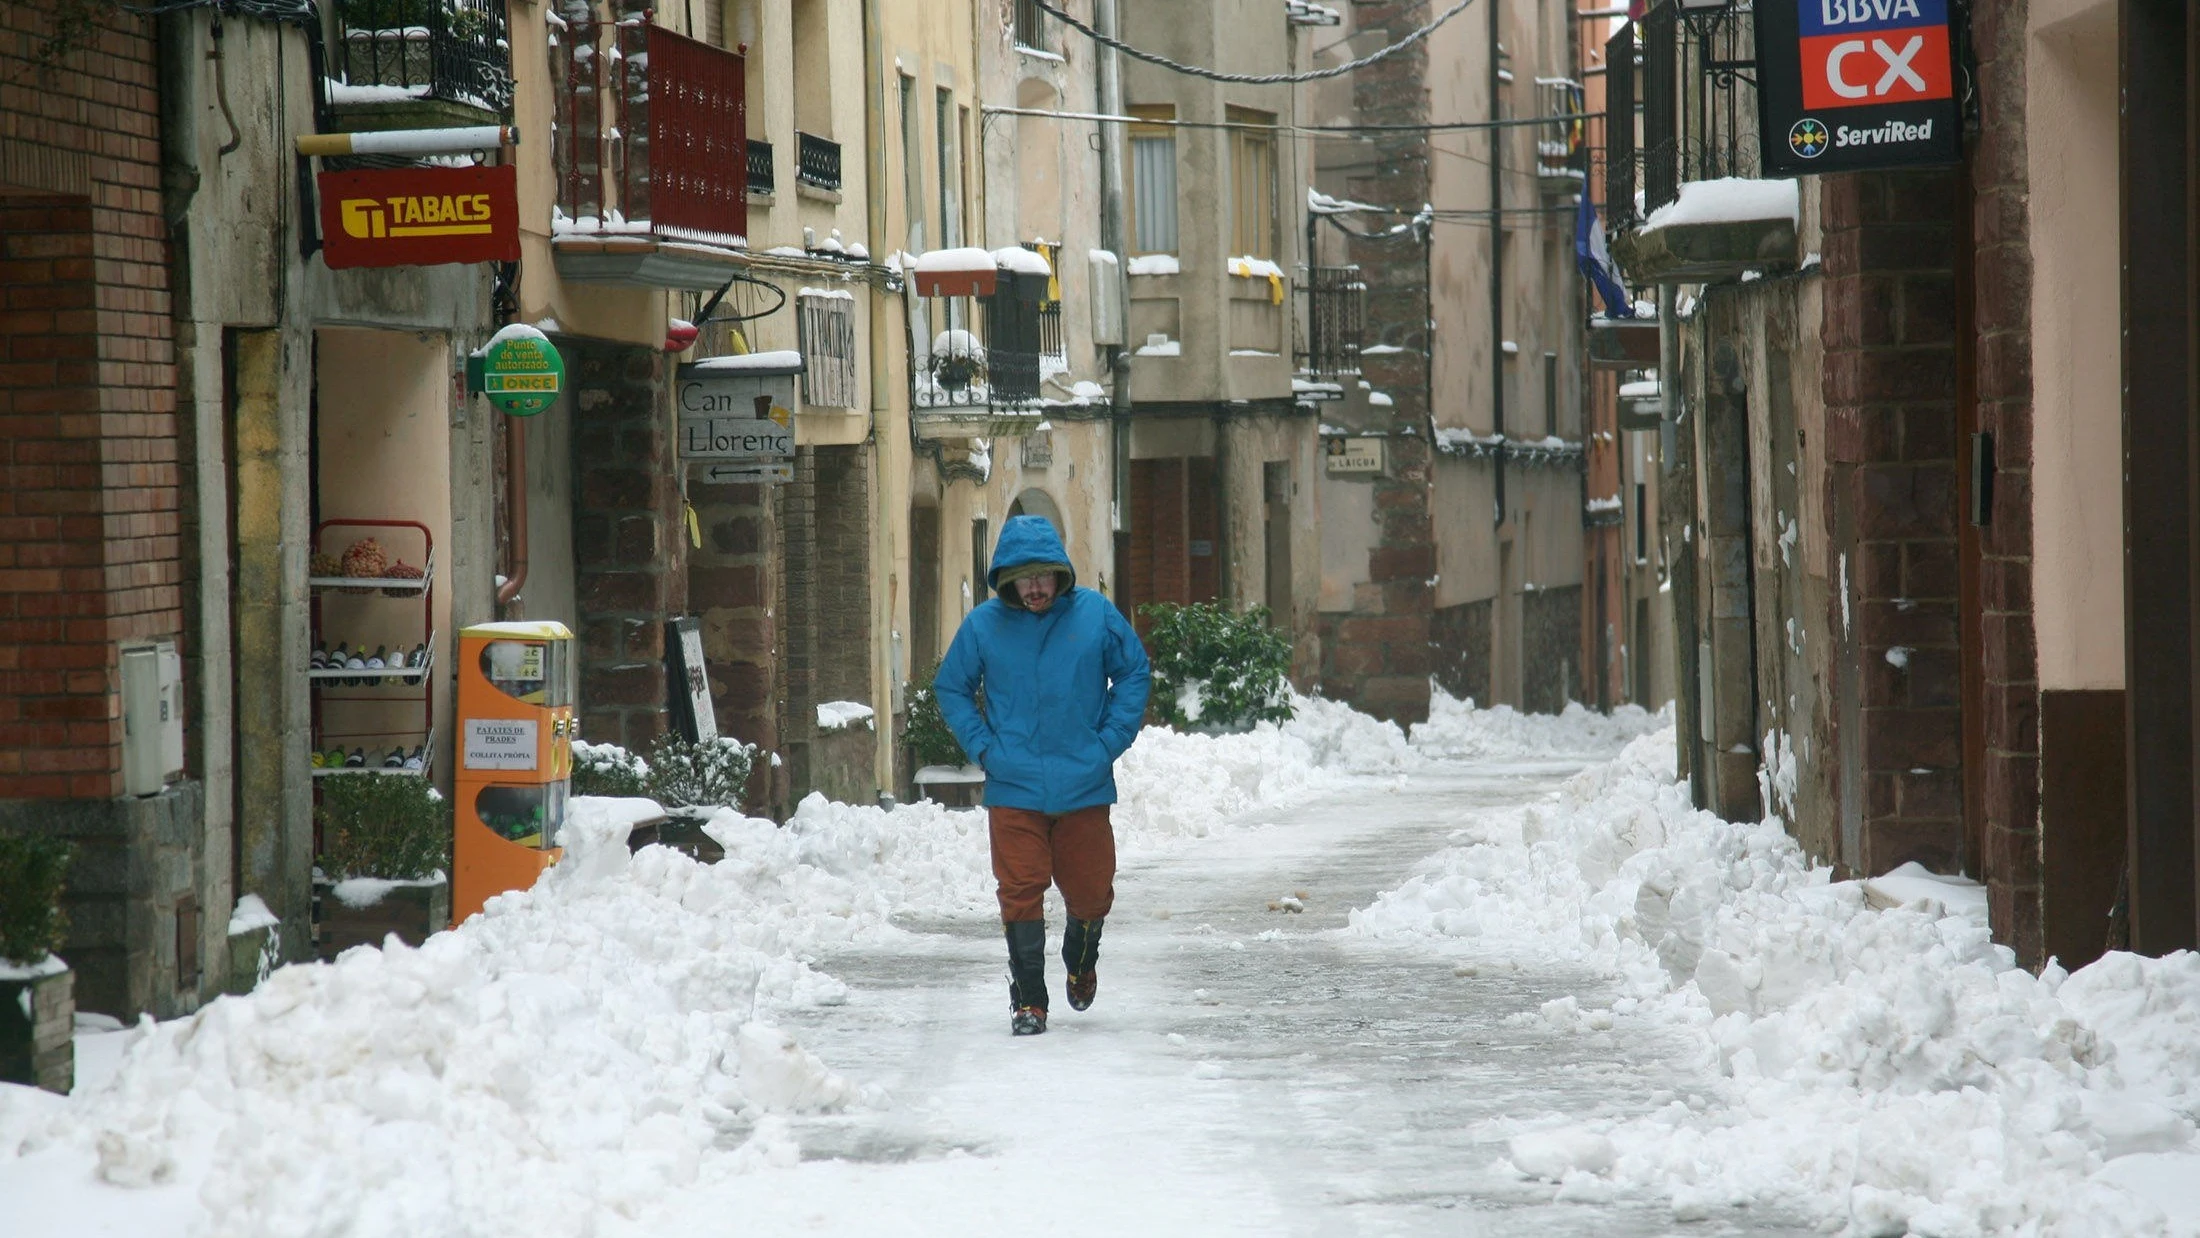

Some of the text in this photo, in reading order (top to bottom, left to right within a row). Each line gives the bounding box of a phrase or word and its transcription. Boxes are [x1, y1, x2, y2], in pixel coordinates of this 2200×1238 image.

[1822, 0, 1920, 25] BBVA
[1826, 35, 1926, 98] CX
[1835, 119, 1932, 147] ServiRed
[386, 194, 490, 223] TABACS
[507, 340, 537, 349] Punto
[501, 350, 543, 360] de venta
[495, 360, 549, 370] autorizado
[507, 377, 552, 389] ONCE
[682, 382, 731, 411] Can
[689, 420, 788, 453] Llorenç
[476, 726, 525, 735] PATATES DE
[485, 735, 517, 744] PRADES
